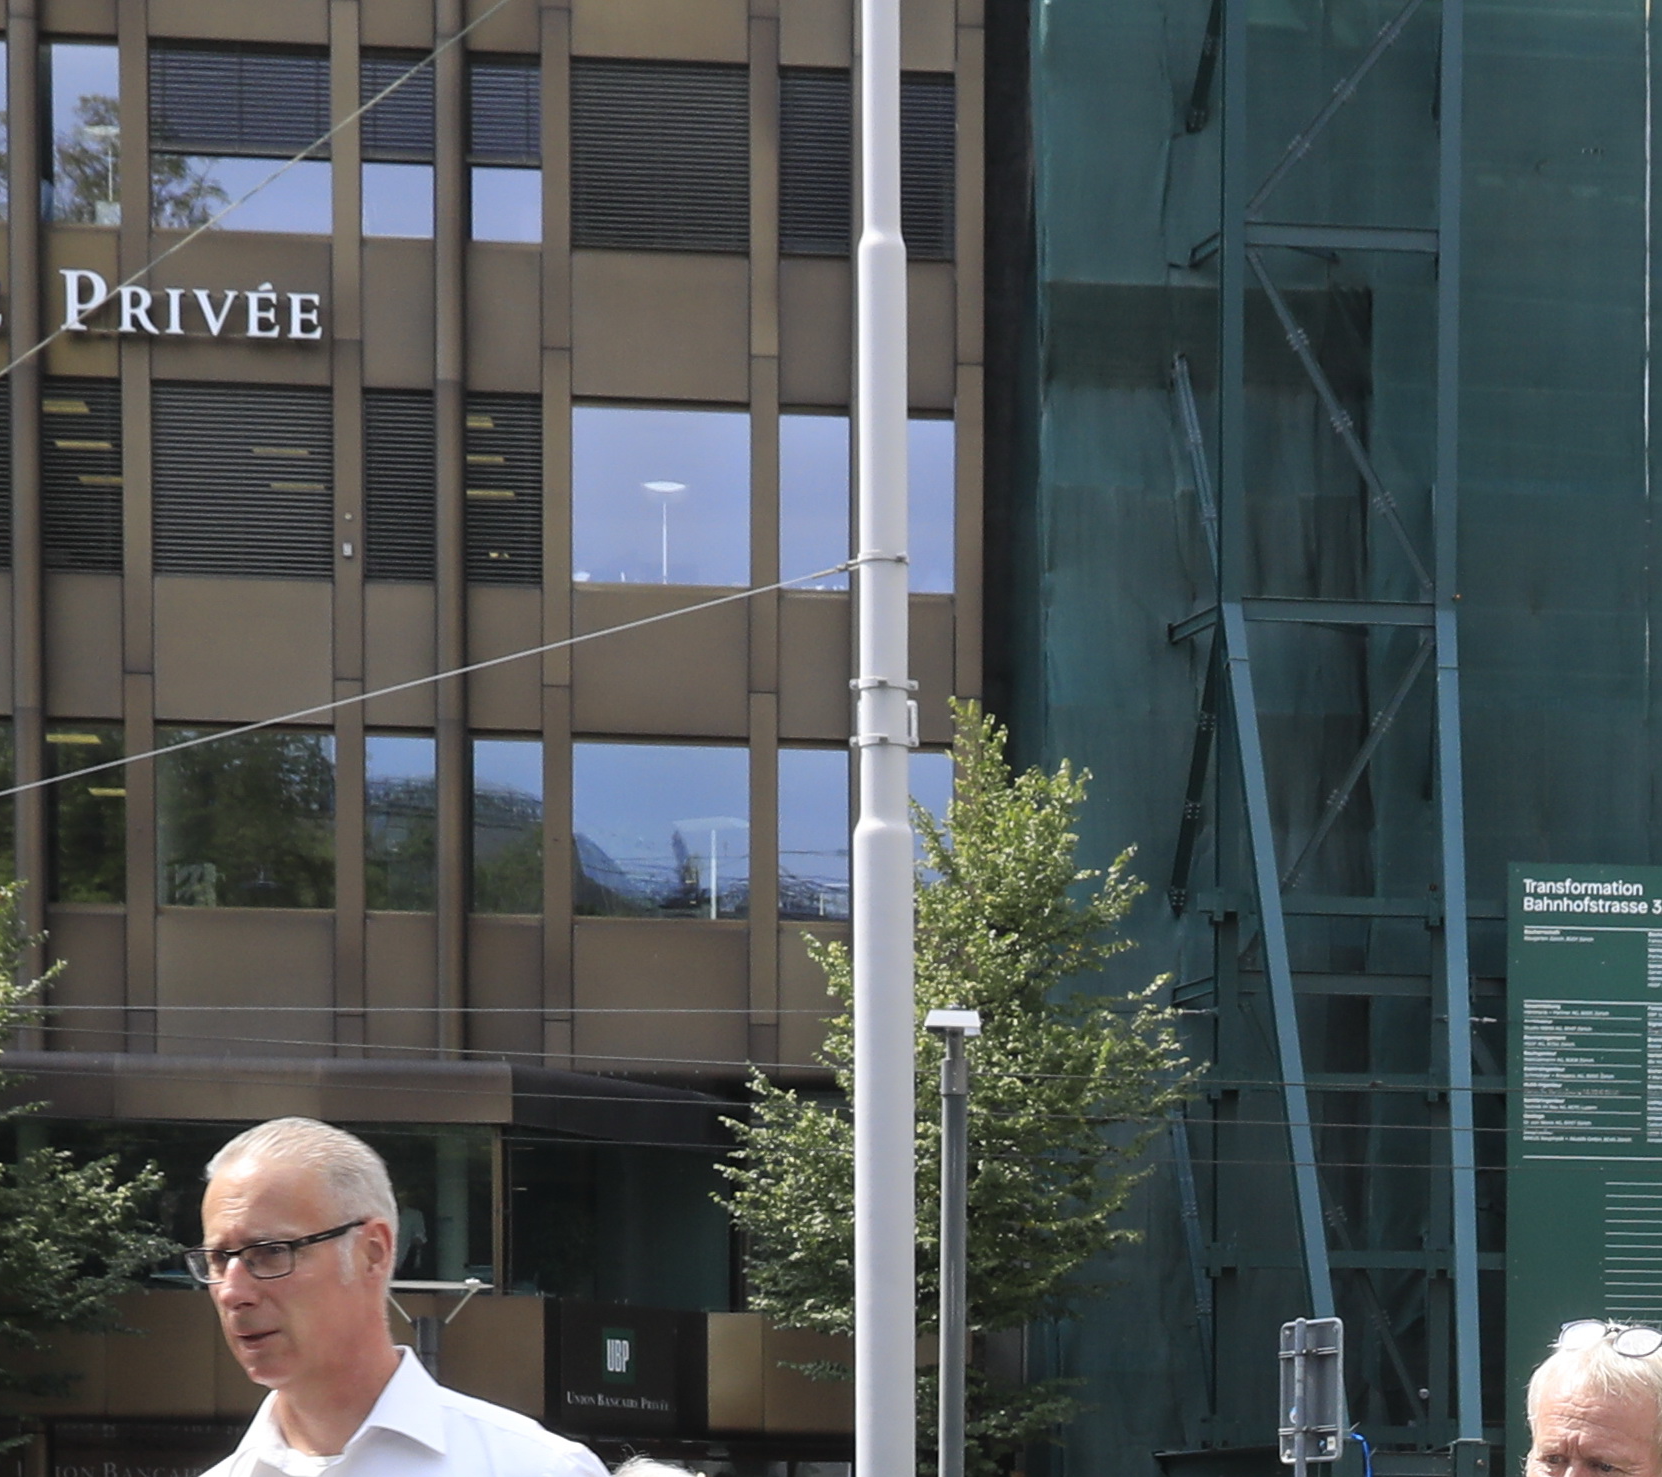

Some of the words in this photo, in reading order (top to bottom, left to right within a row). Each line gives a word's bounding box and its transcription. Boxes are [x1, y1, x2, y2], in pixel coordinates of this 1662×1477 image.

[59, 268, 324, 340] PRIVÉE
[1522, 878, 1643, 896] Transformation
[1522, 896, 1648, 915] Bahnhofstrasse
[606, 1338, 630, 1373] UBP
